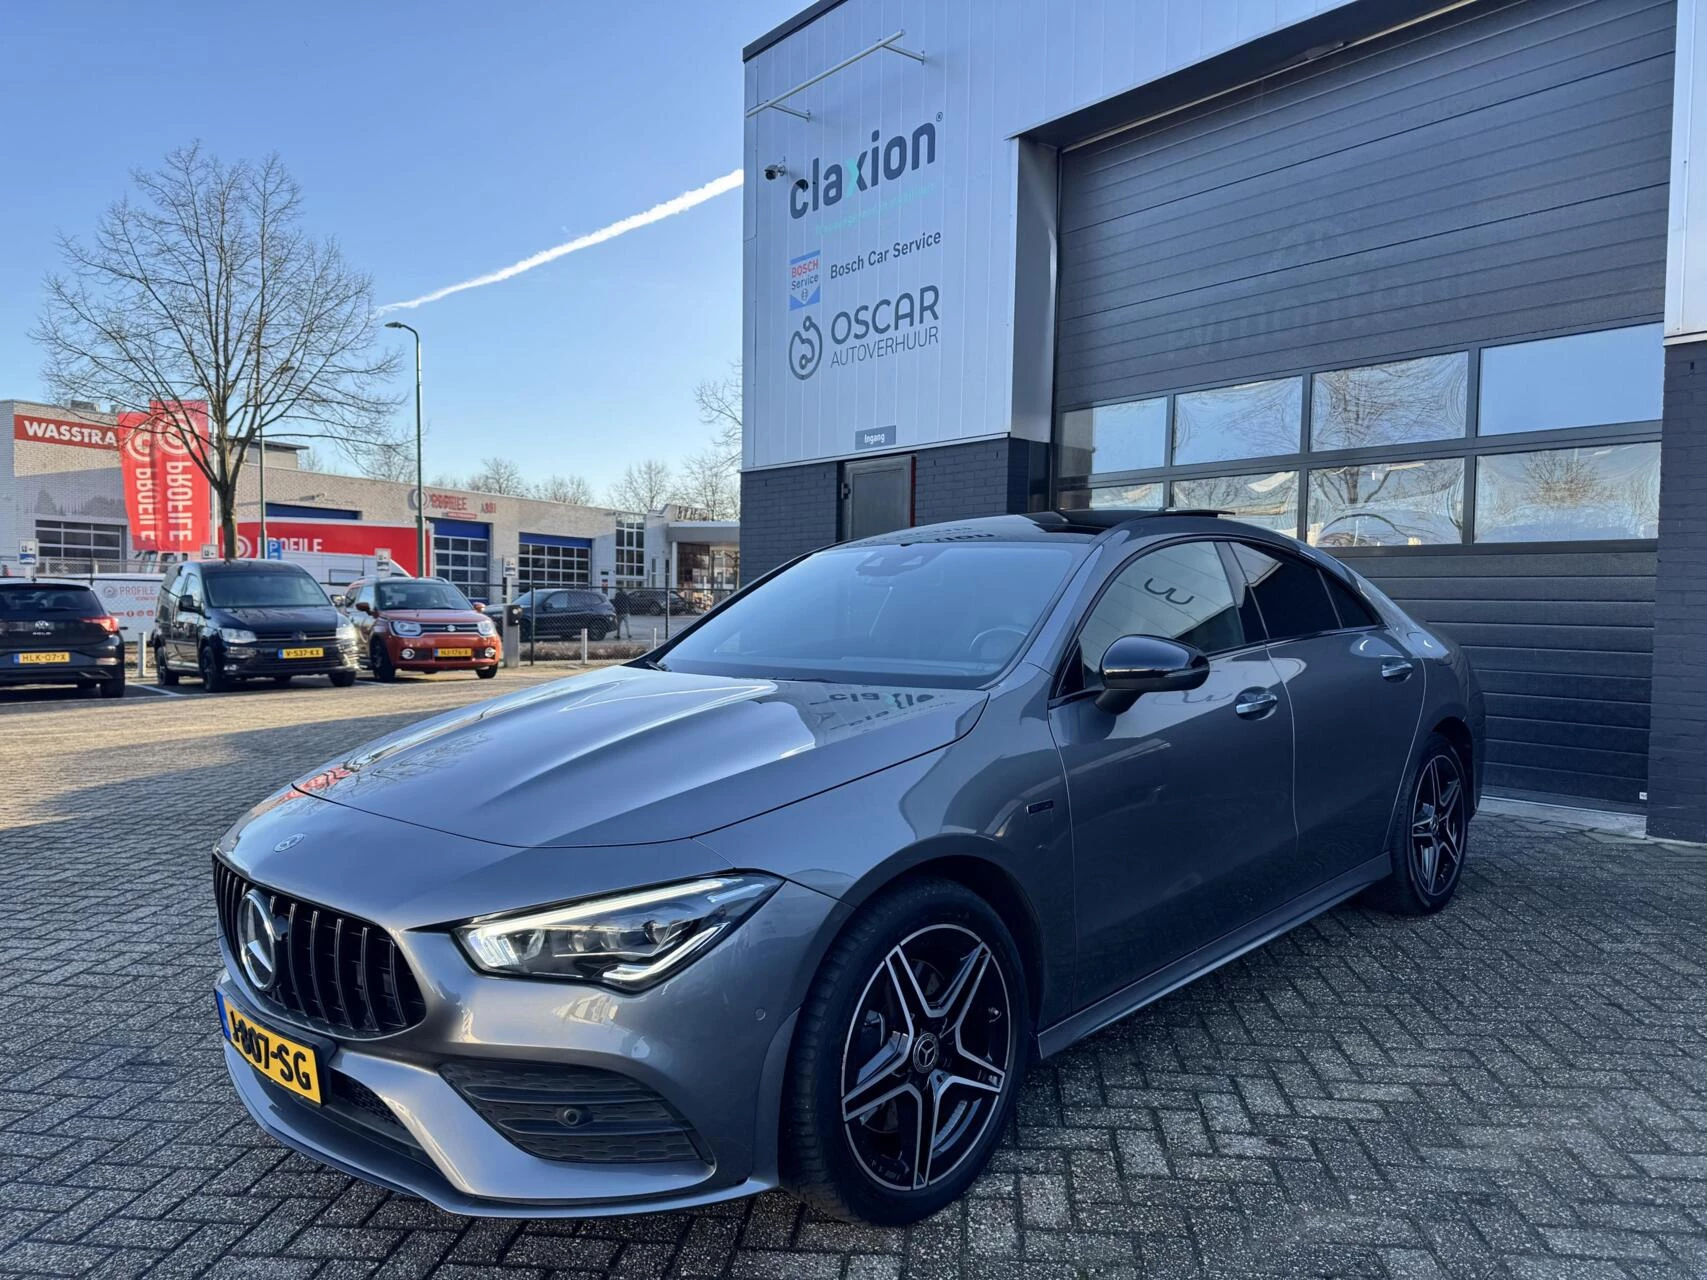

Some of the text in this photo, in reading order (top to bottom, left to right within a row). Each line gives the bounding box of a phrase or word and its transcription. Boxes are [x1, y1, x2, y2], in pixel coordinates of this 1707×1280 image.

[789, 122, 936, 220] claxion
[791, 258, 819, 279] BOSCH
[830, 231, 942, 280] Bosch Car Service
[791, 273, 819, 291] Service
[830, 284, 940, 346] OSCAR
[830, 325, 939, 369] AUTOVERHUUR
[23, 420, 118, 447] WASSTRA
[864, 433, 885, 445] Ingang
